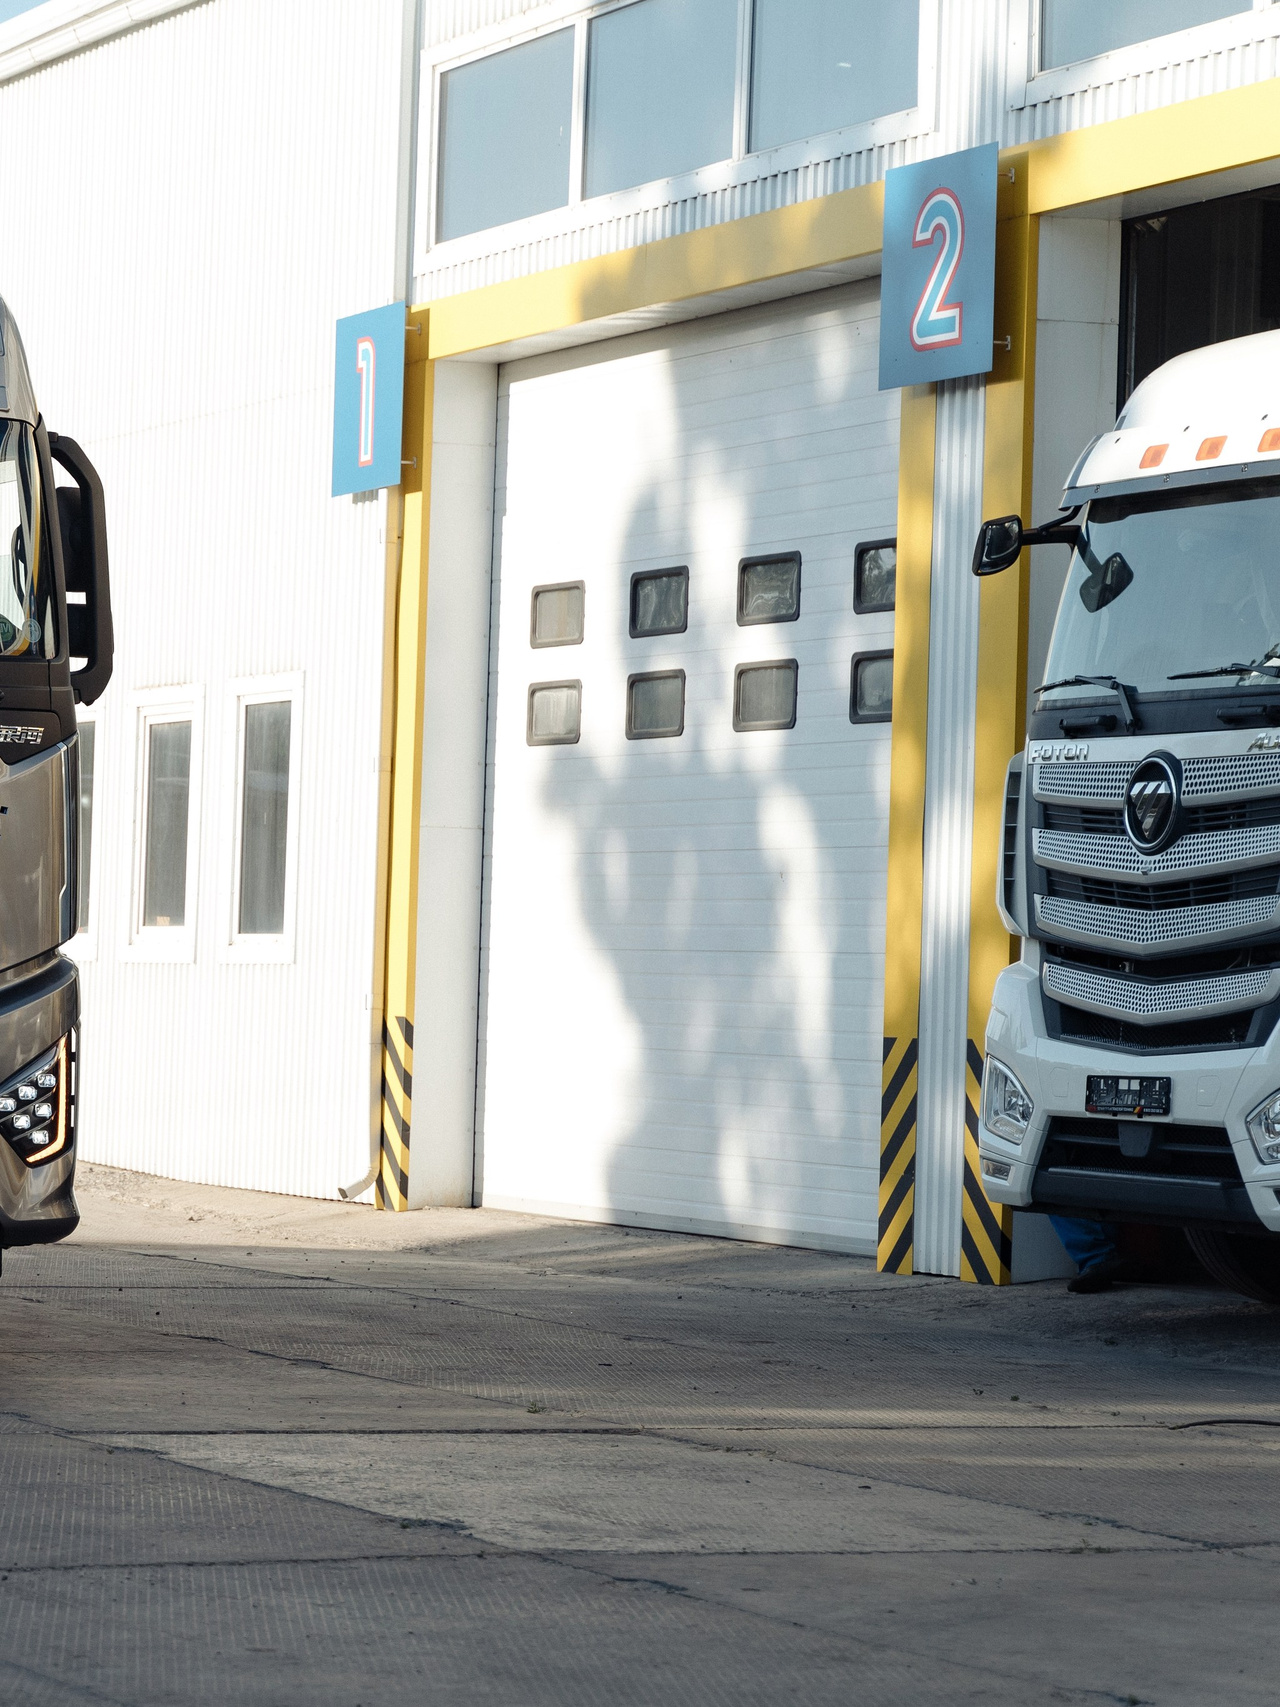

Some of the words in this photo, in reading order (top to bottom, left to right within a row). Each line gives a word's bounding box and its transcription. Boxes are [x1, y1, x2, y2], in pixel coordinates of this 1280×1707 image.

[910, 187, 965, 352] 2
[356, 336, 376, 468] 1
[1032, 744, 1089, 762] FOTON
